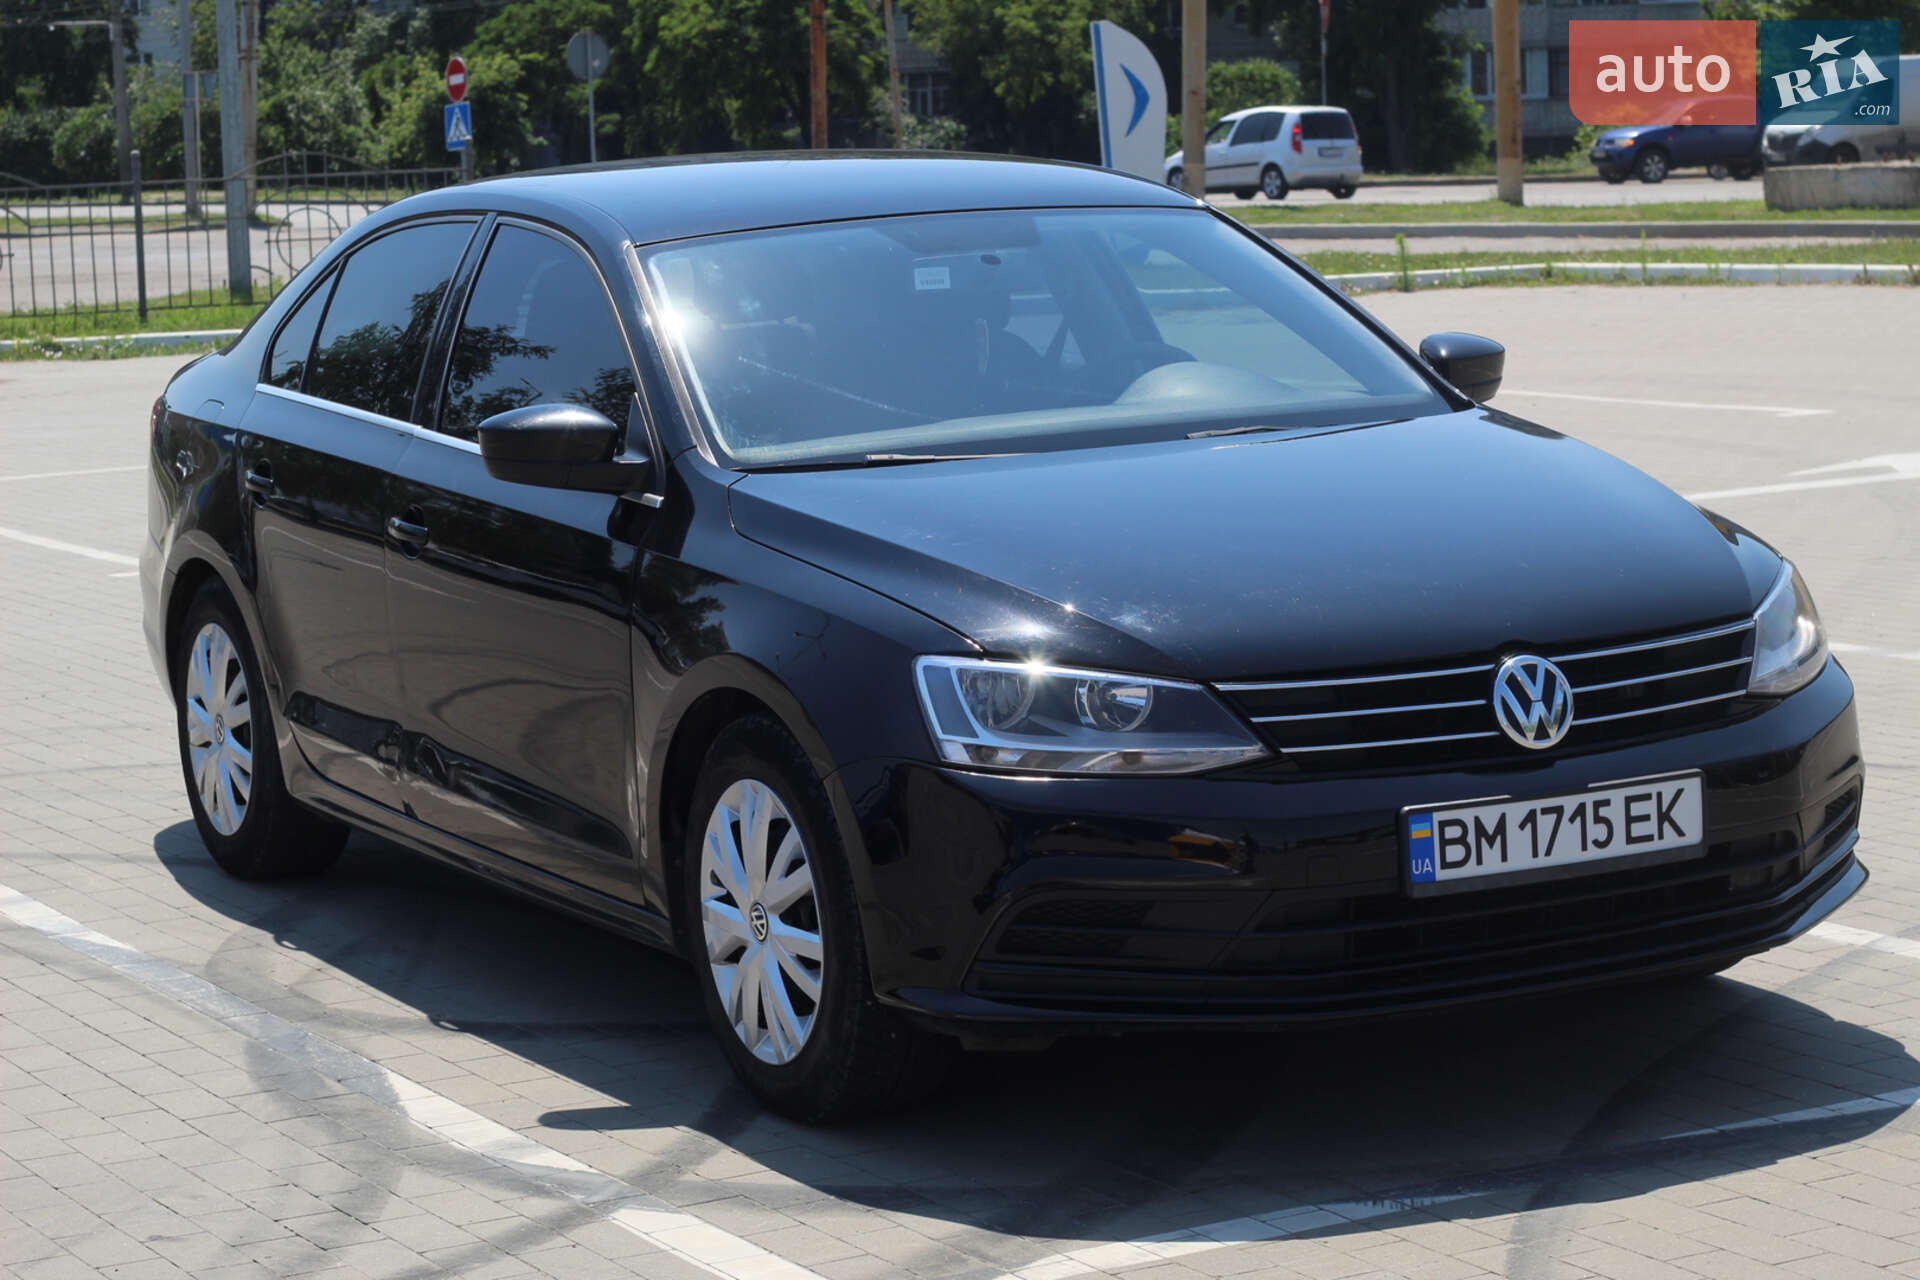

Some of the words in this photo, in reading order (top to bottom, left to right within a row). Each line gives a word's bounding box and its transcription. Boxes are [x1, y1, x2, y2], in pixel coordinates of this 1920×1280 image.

[1438, 812, 1508, 870] BM
[1518, 798, 1614, 859] 1715
[1624, 788, 1686, 846] EK
[1411, 857, 1433, 875] UA
